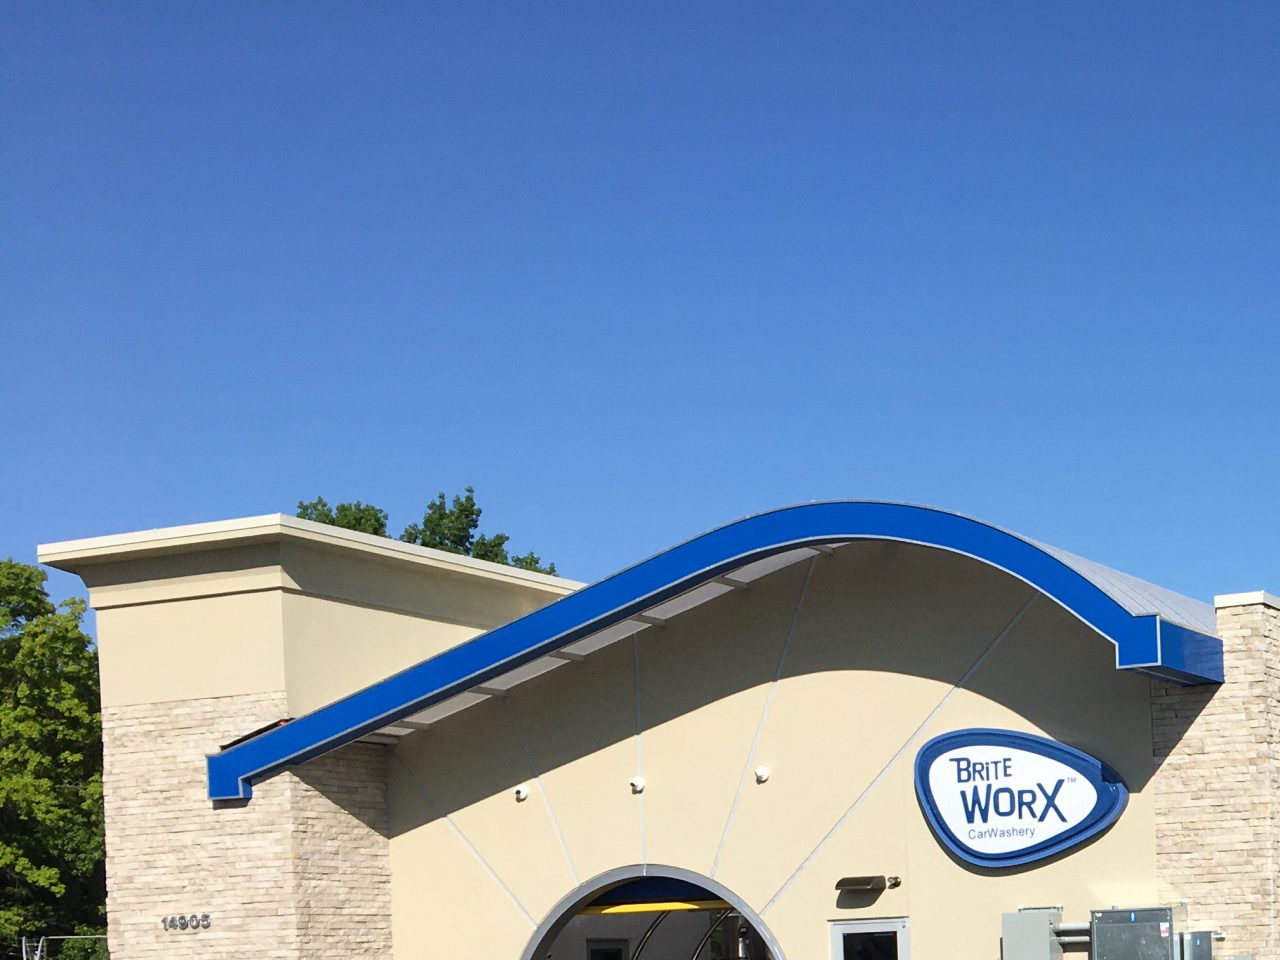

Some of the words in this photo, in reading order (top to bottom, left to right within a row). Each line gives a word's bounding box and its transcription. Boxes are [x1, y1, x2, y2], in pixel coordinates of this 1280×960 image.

[960, 779, 1068, 824] WORX
[968, 827, 1036, 840] CarWashery
[161, 913, 211, 931] 14905
